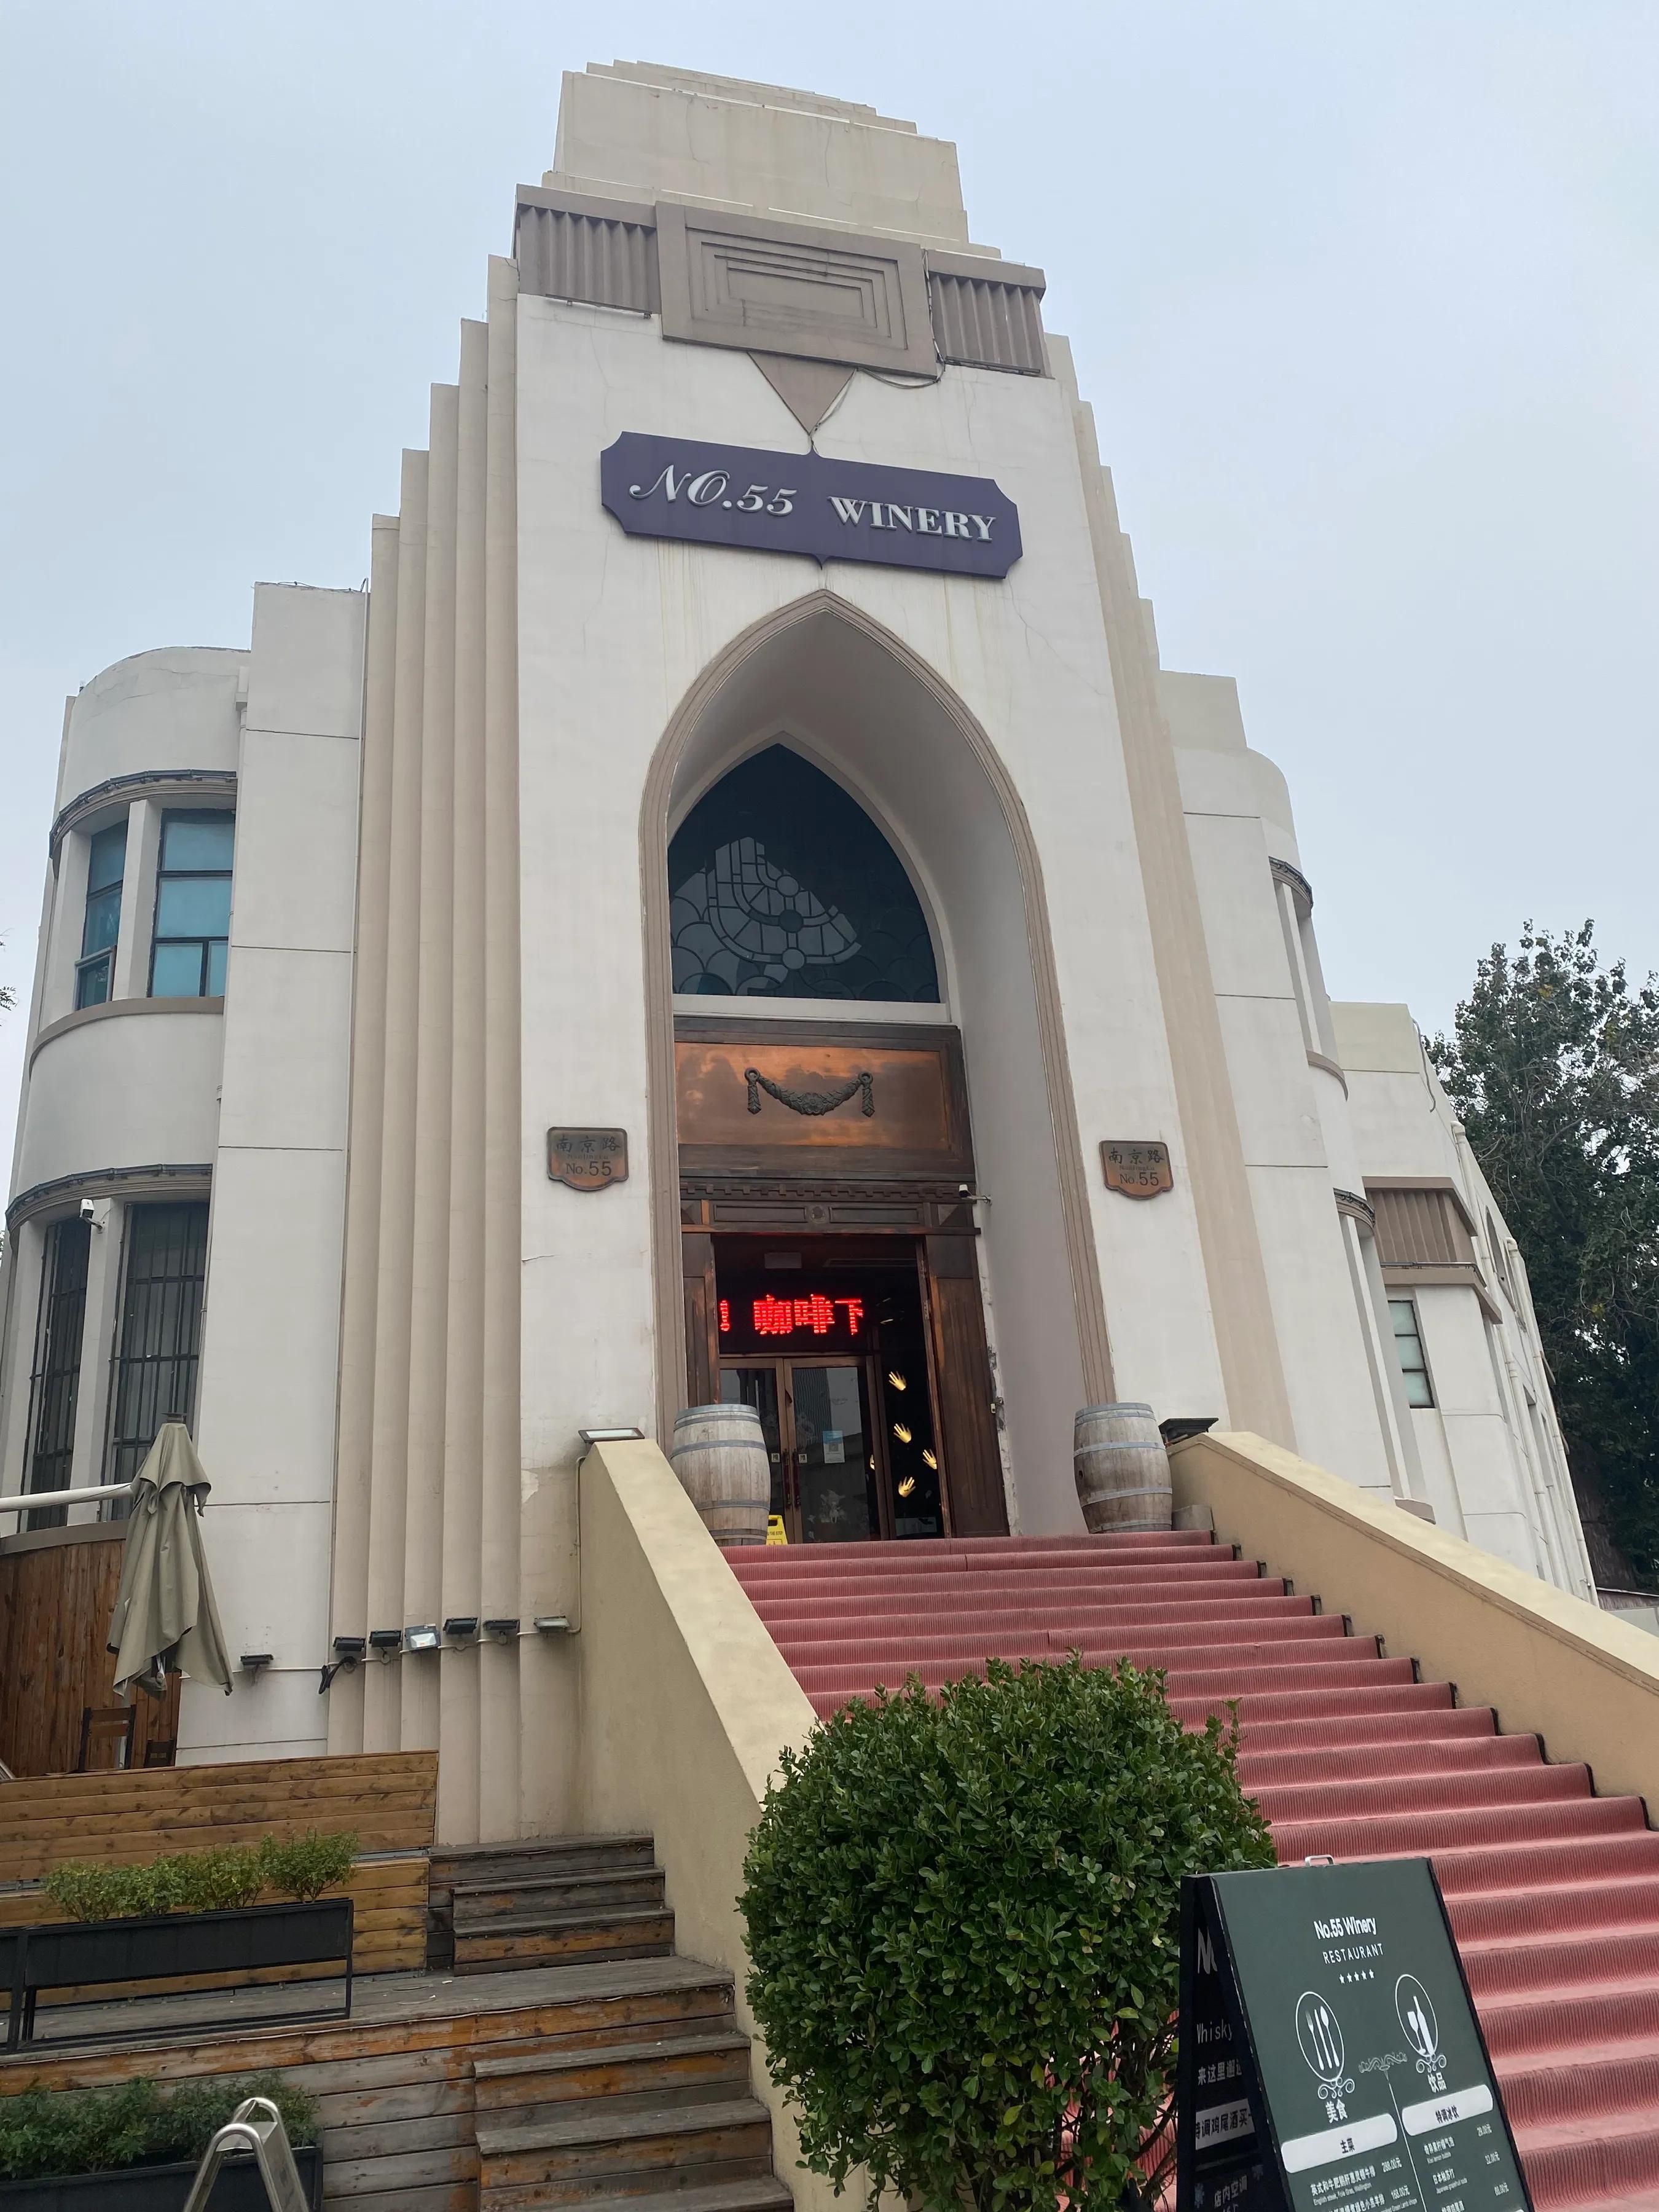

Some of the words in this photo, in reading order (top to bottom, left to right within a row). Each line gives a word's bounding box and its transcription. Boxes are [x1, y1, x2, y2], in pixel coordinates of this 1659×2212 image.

[629, 464, 798, 516] NO.55
[827, 496, 996, 543] WINERY
[556, 1134, 621, 1153] 南京路
[1108, 1147, 1165, 1165] 南京路
[565, 1161, 612, 1176] No.55
[1119, 1172, 1159, 1186] No.55
[1313, 1918, 1344, 1939] No.55
[1322, 1943, 1384, 1964] RESTAURANT
[1427, 2071, 1447, 2093] 饮品
[1325, 2098, 1348, 2124] 美食
[1340, 2137, 1355, 2154] 主菜
